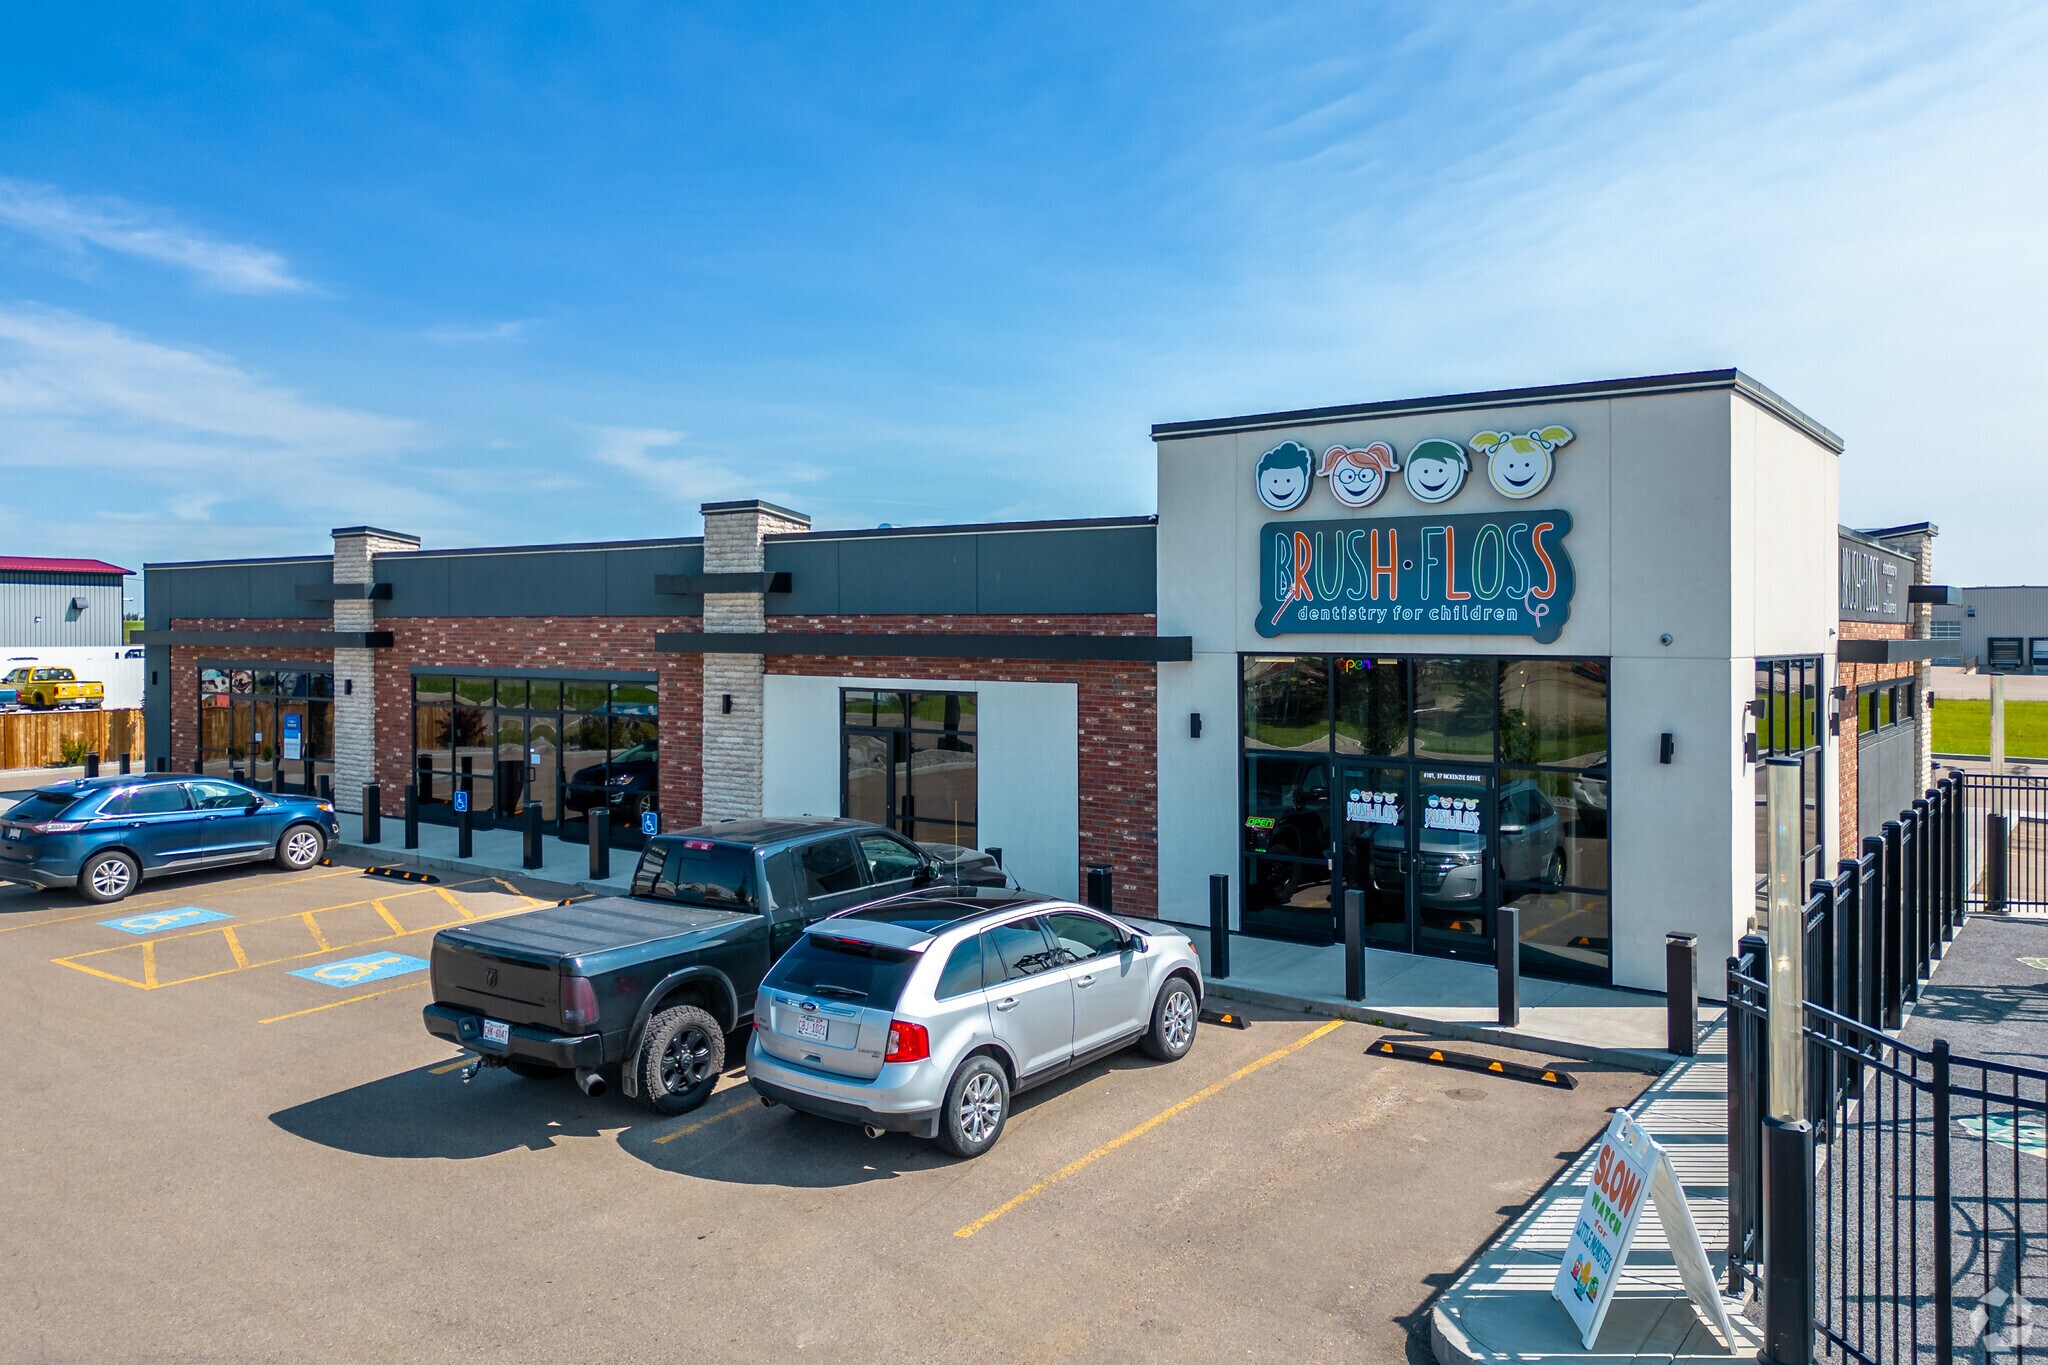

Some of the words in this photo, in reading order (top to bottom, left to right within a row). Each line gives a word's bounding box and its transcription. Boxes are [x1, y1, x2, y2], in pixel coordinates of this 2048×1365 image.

[1275, 529, 1398, 601] BRUSH
[1420, 522, 1557, 601] FLOSS
[1298, 606, 1388, 623] dentistry
[1393, 605, 1423, 621] for
[1429, 604, 1518, 621] children
[1338, 659, 1371, 673] open
[1247, 817, 1274, 827] OPEN
[1594, 1145, 1641, 1218] SLOW
[1592, 1191, 1622, 1237] WATCH
[1576, 1218, 1594, 1249] LITTLE
